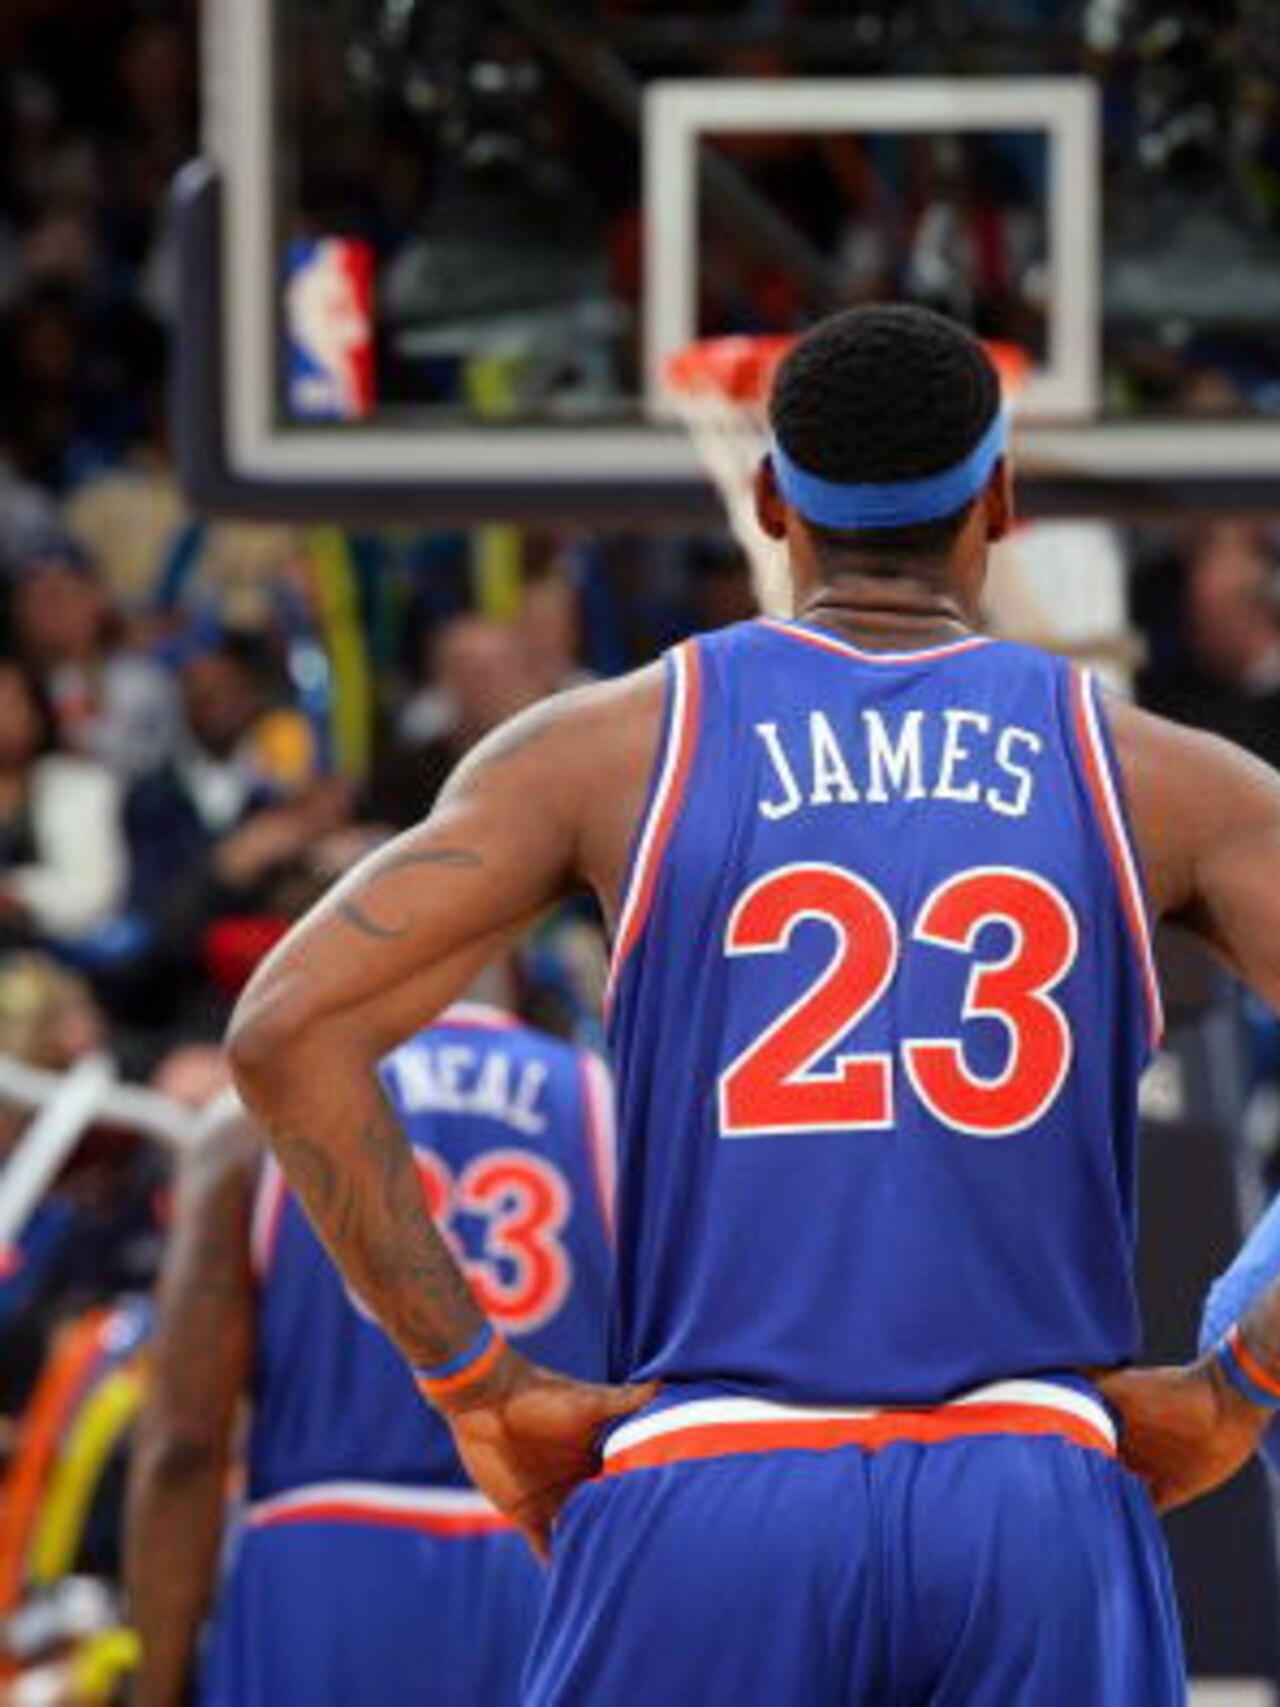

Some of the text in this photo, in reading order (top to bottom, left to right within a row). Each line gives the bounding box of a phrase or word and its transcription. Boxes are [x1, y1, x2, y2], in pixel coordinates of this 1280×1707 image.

[755, 709, 1041, 820] JAMES
[718, 861, 1079, 1138] 23
[413, 1148, 573, 1335] 3
